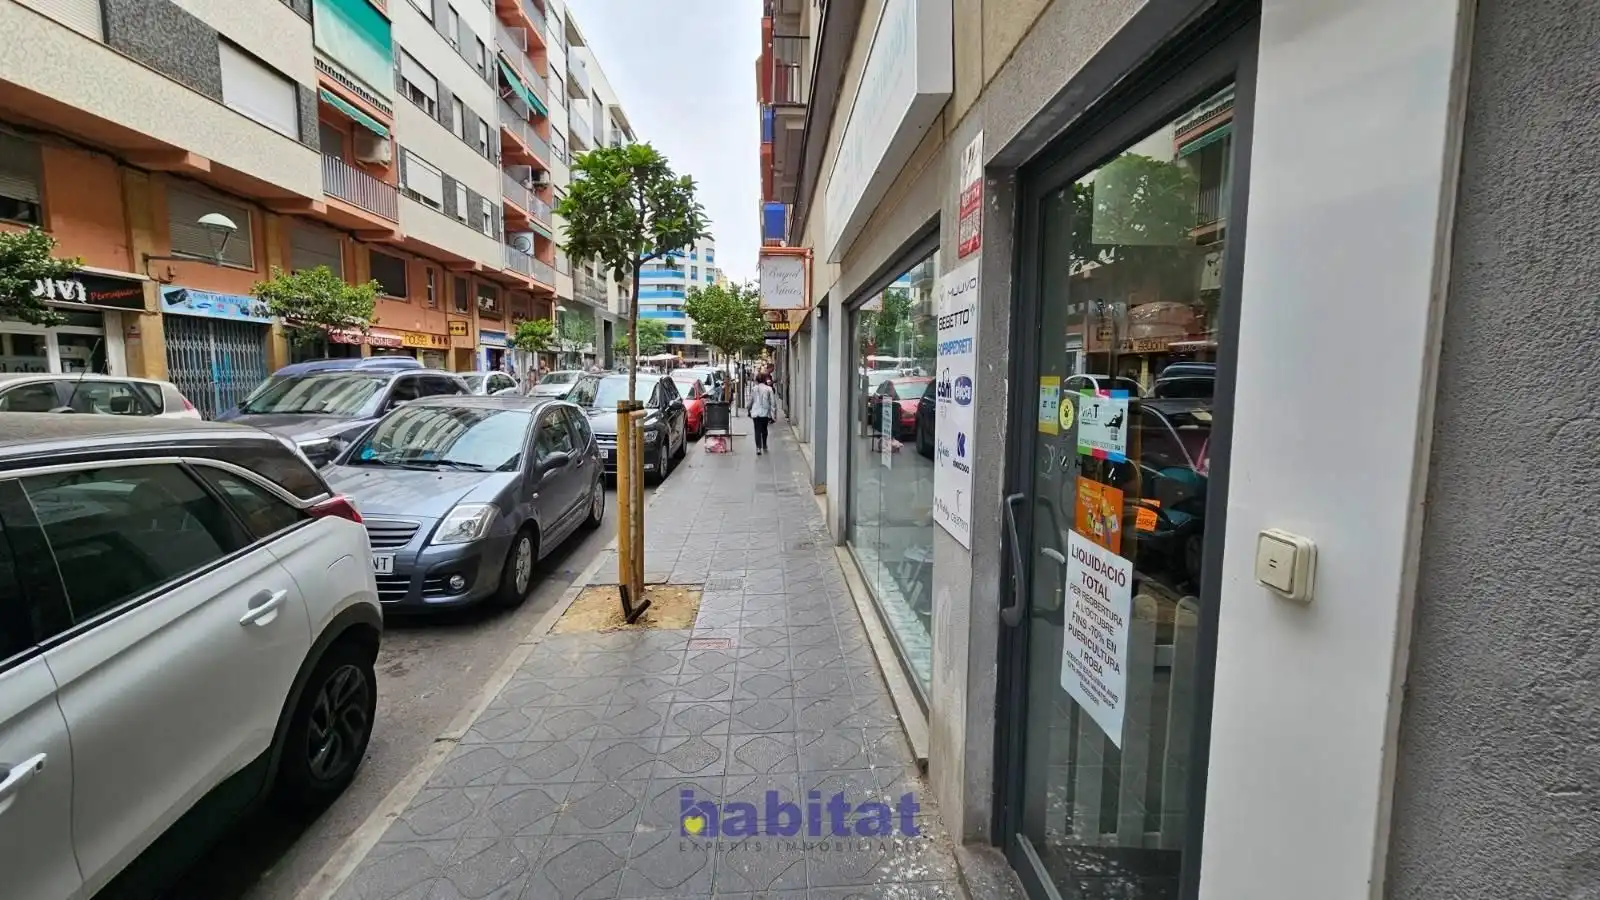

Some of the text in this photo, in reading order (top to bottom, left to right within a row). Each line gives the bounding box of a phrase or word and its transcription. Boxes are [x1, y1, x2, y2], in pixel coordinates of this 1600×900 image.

[938, 308, 970, 331] BEBETTO
[1071, 543, 1126, 588] LIQUIDACIÓ
[1081, 571, 1111, 602] TOTAL
[1069, 582, 1123, 628] PER REOBERTURA
[1068, 623, 1121, 675] PUERICULTURA
[1072, 611, 1087, 630] FINS
[1106, 637, 1117, 655] EN
[1084, 651, 1103, 678] ROBA
